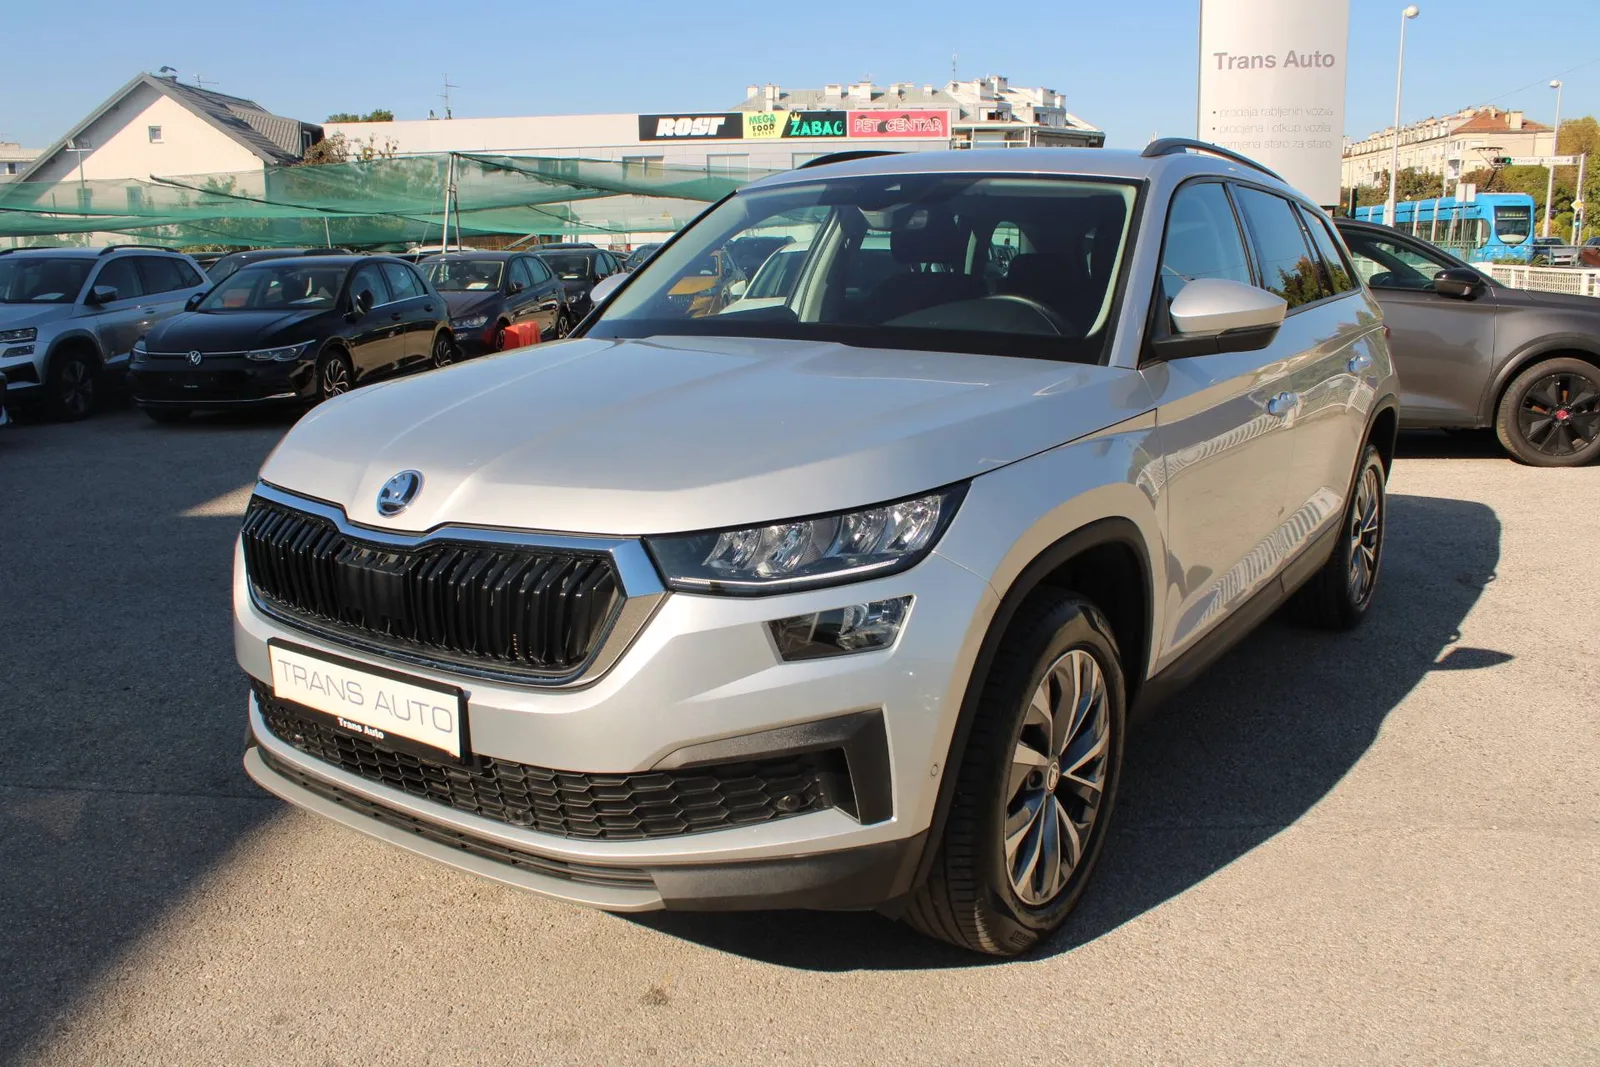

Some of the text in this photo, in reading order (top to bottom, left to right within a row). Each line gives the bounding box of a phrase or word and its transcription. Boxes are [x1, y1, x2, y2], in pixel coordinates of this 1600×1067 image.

[1213, 50, 1335, 70] Trans Auto
[656, 117, 725, 136] ROST
[749, 114, 776, 125] MEGA
[752, 123, 775, 132] FOOD
[854, 118, 942, 133] PET CENTAR
[1264, 140, 1289, 149] staro
[1293, 141, 1304, 149] za
[1307, 140, 1332, 149] staro
[278, 659, 453, 734] TRANS AUTO
[337, 716, 384, 740] Trans Auto
